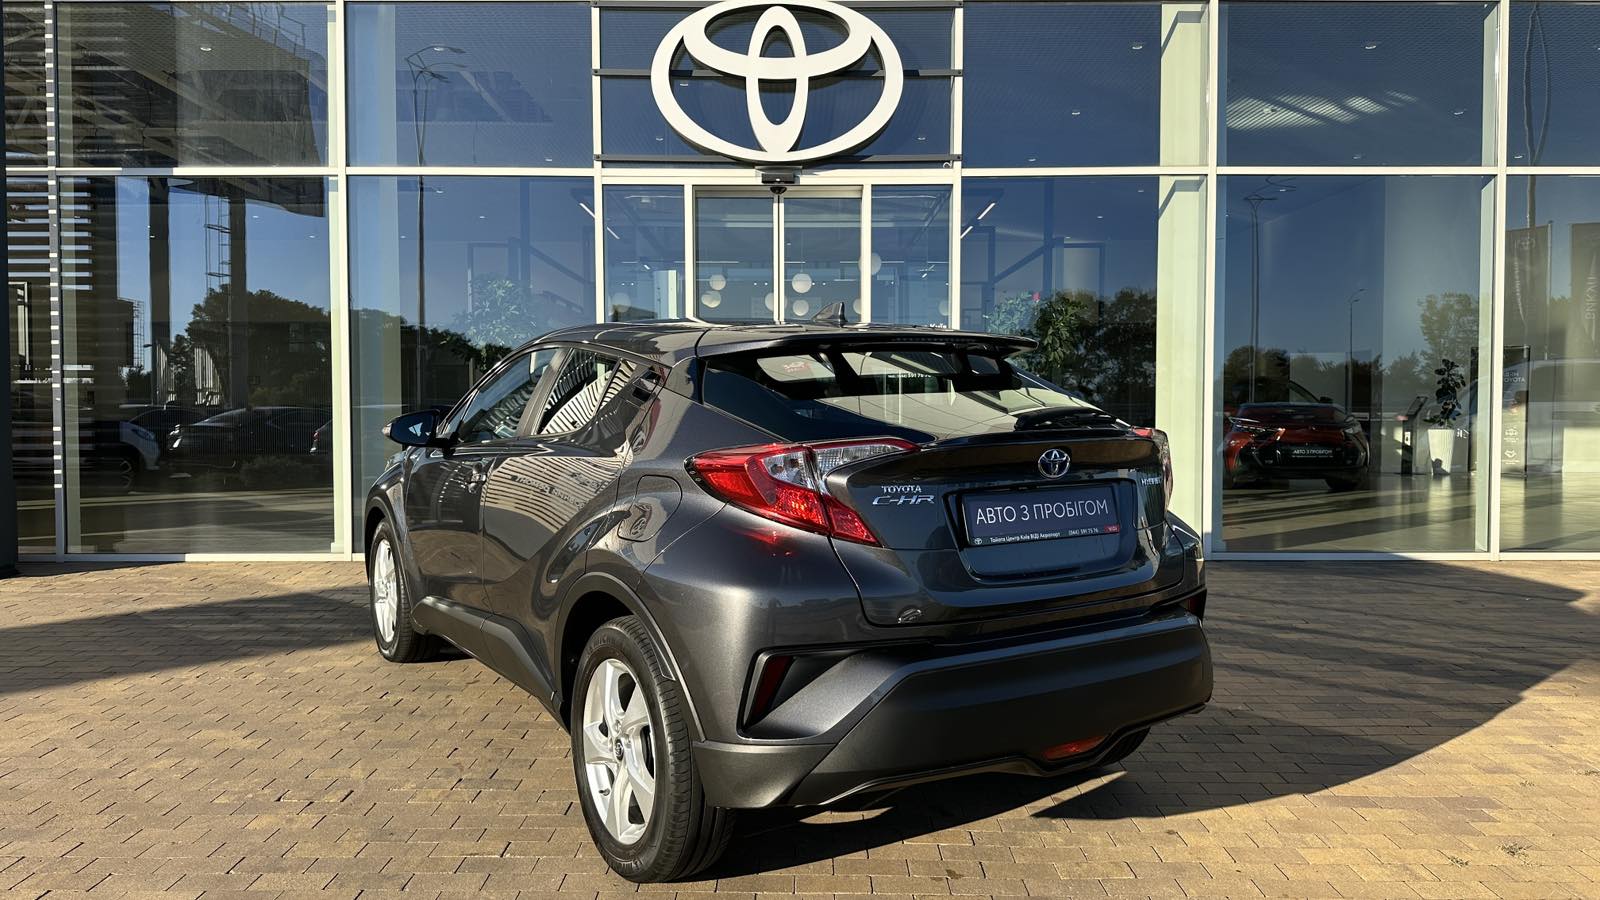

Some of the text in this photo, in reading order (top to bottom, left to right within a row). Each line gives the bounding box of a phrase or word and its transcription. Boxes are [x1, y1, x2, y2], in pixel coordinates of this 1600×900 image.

[1503, 376, 1526, 384] OYOTA
[881, 484, 922, 494] TOYOTA
[872, 495, 935, 506] C-HR
[976, 499, 1109, 525] АВТО З ПРОБІГОМ
